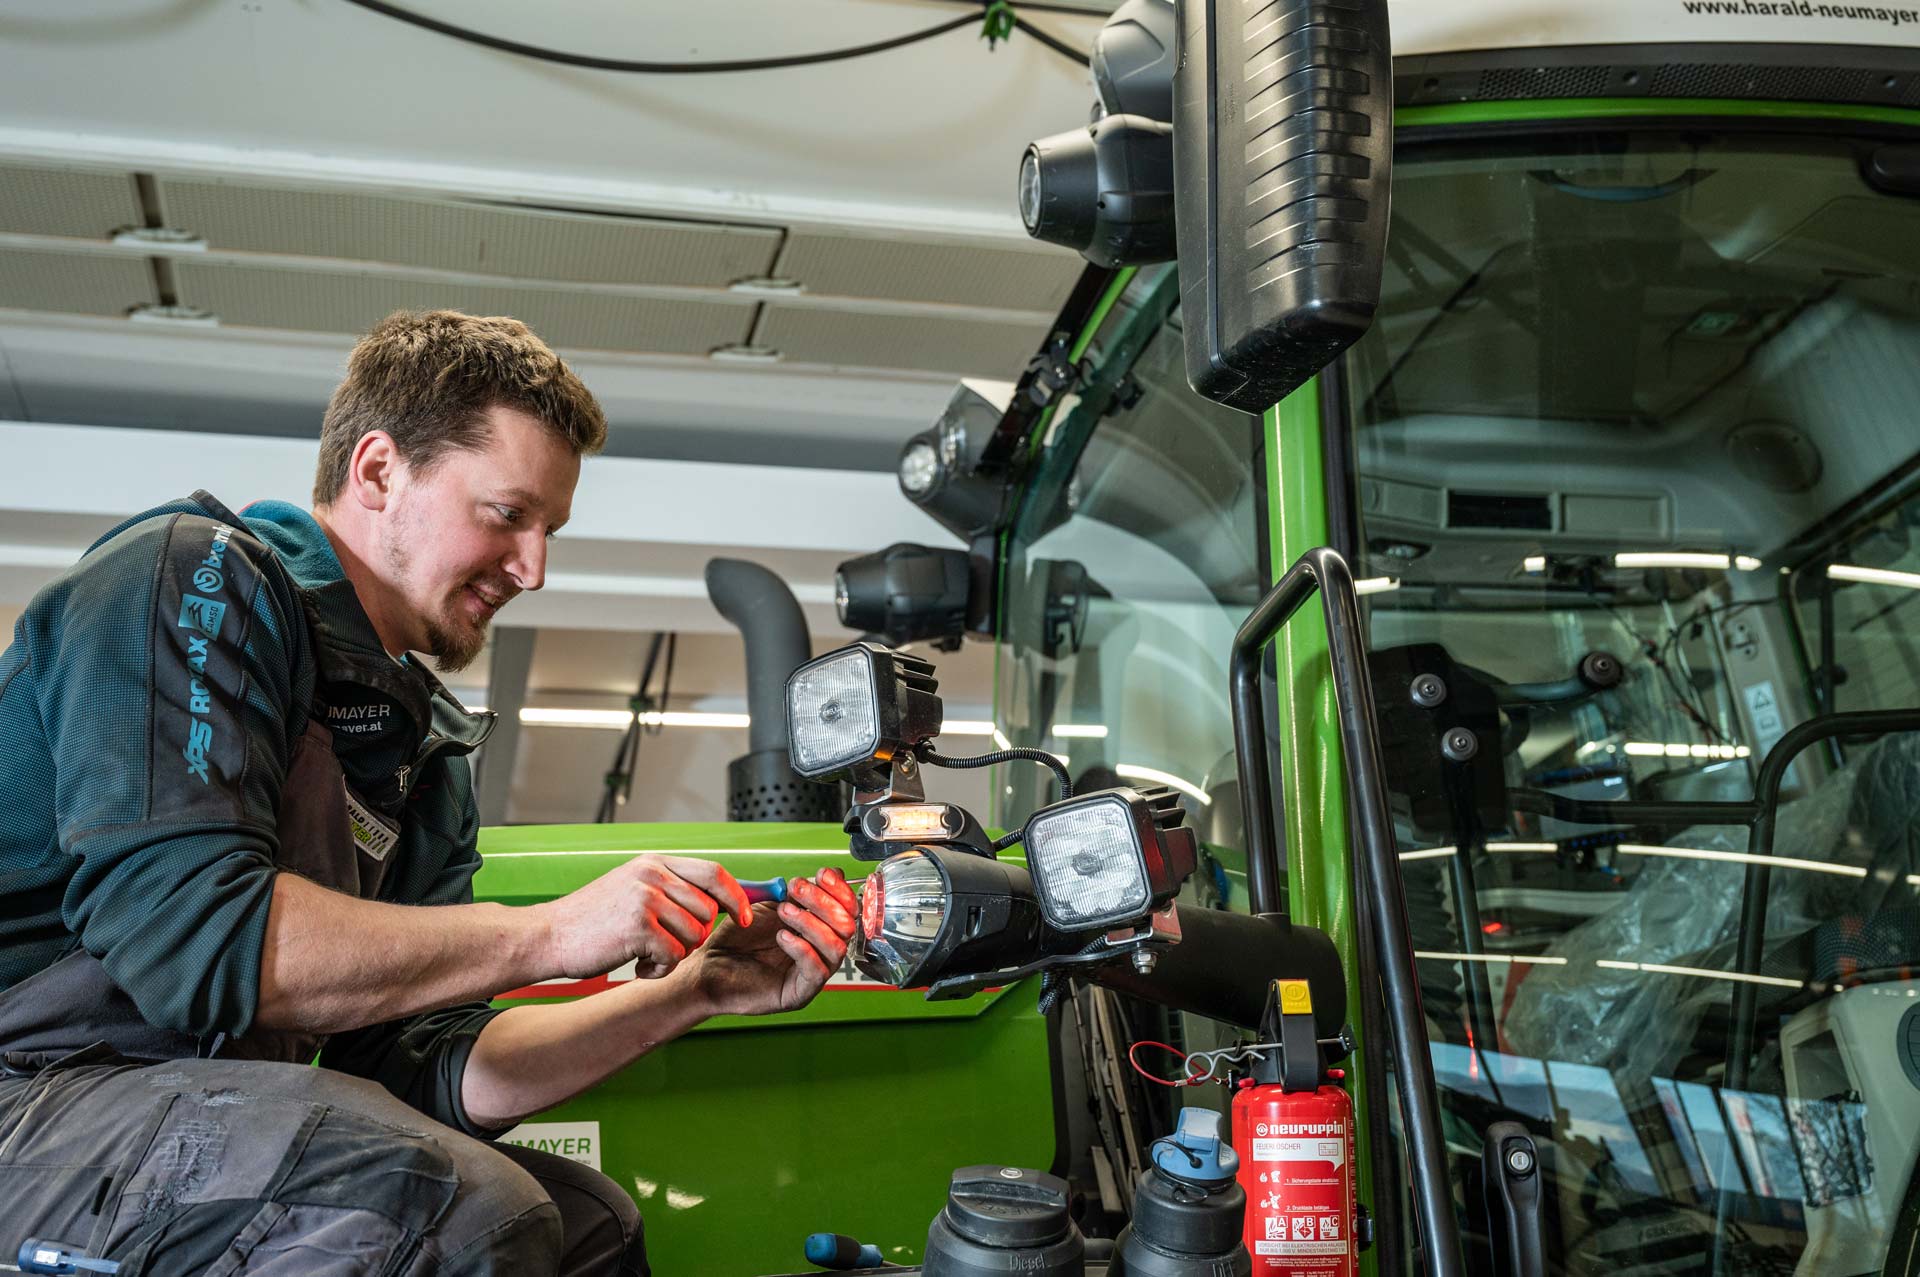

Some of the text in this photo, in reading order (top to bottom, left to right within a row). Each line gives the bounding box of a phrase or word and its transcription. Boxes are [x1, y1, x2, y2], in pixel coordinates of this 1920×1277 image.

[1683, 0, 1919, 25] www.harald-neumayer
[205, 606, 219, 633] CAMSO
[189, 636, 210, 713] ROAX
[331, 721, 383, 733] ayer.at
[1269, 1120, 1344, 1137] neuruppin
[1277, 1217, 1287, 1227] A
[1306, 1217, 1314, 1227] B
[1331, 1216, 1338, 1226] C
[1009, 1252, 1045, 1272] Diesel
